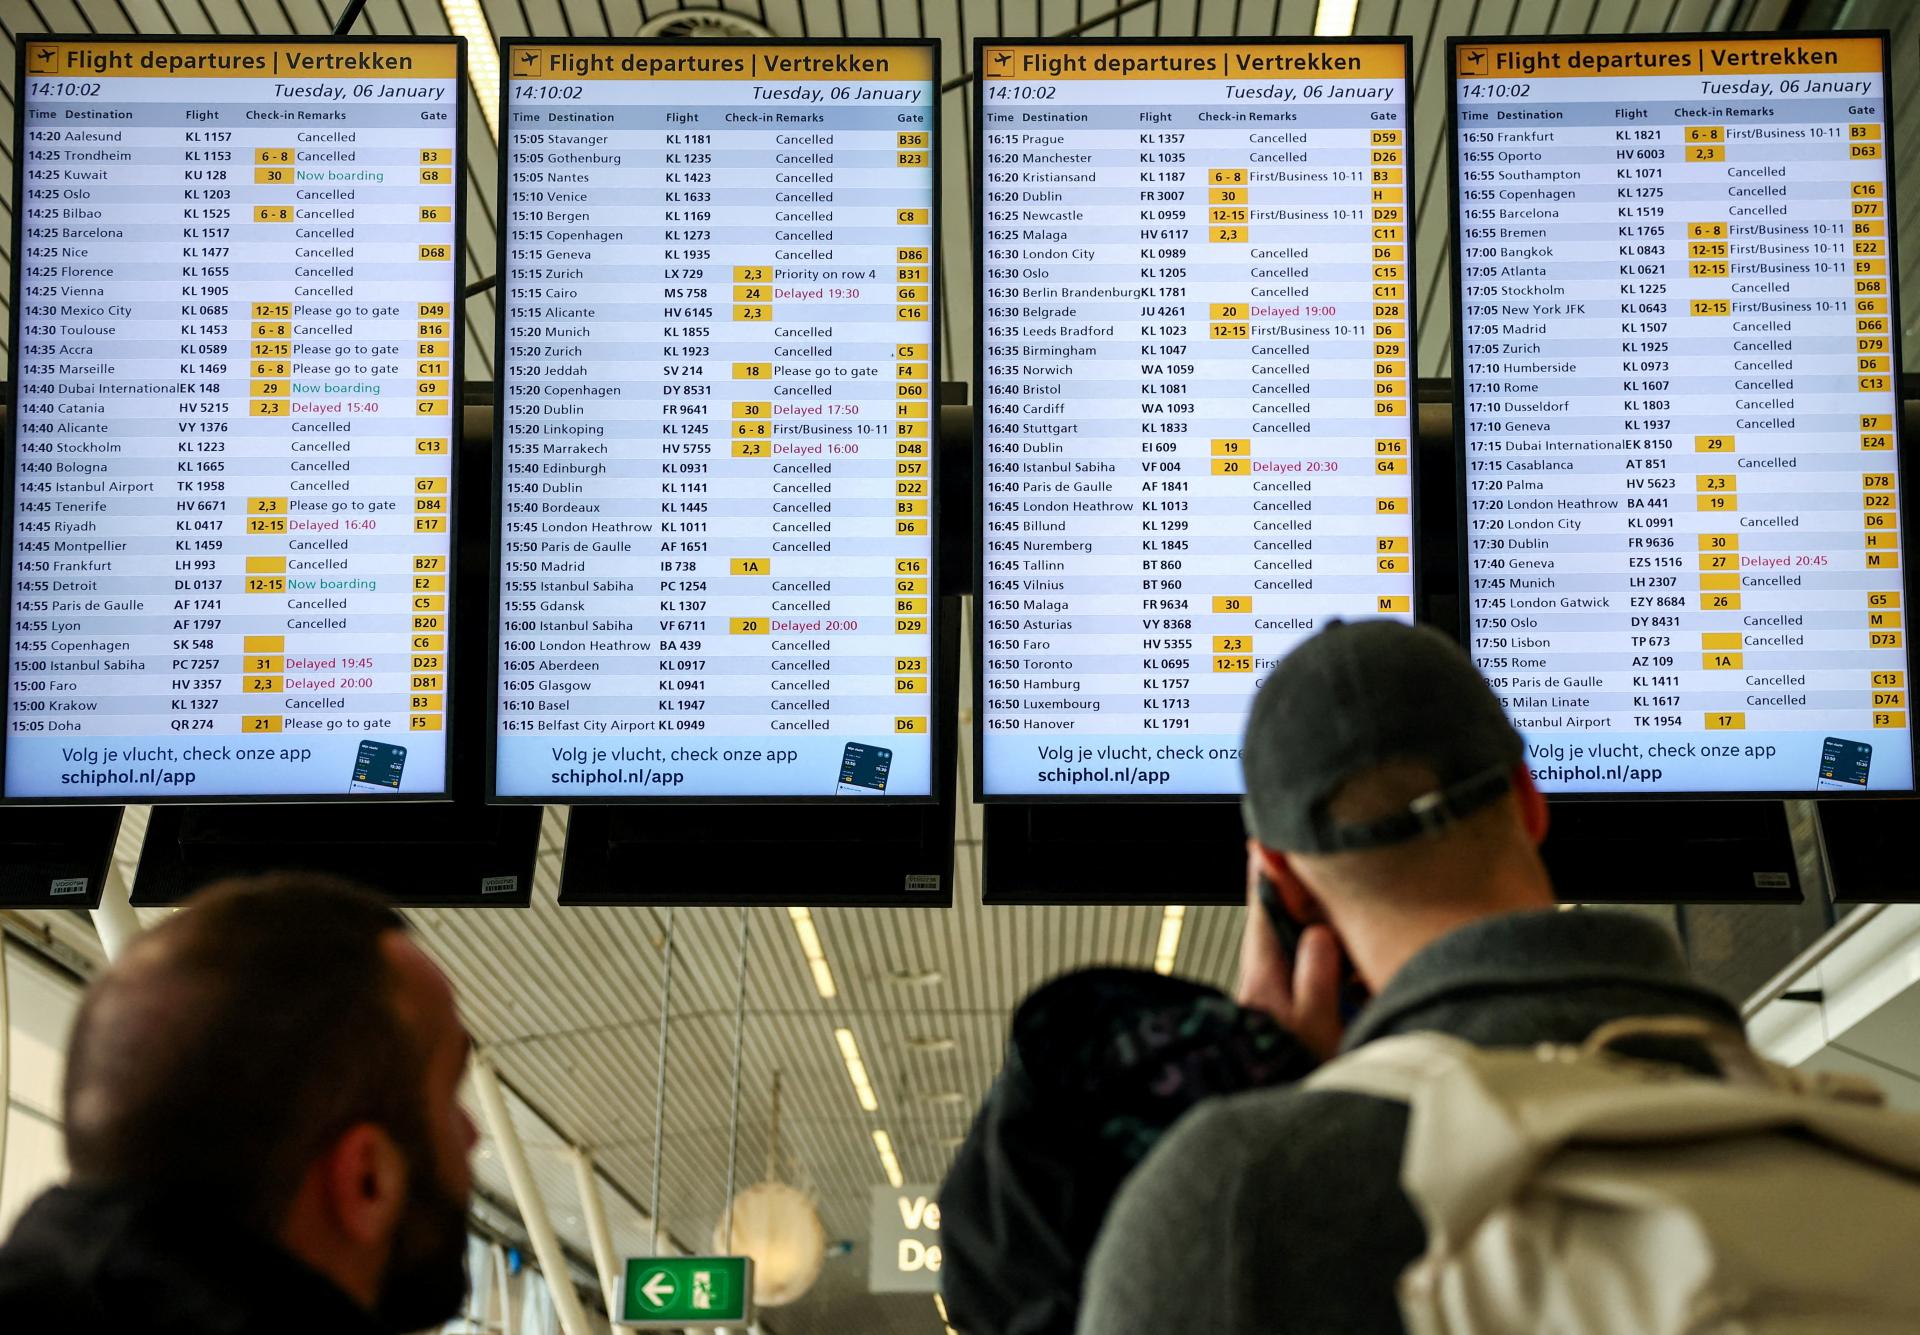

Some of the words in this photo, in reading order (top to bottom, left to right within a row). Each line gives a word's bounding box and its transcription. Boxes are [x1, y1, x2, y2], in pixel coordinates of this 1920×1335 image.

[67, 49, 133, 74] Flight
[140, 48, 266, 75] departures
[285, 51, 412, 70] Vertrekken
[550, 53, 615, 77] Flight
[621, 53, 745, 77] departures
[763, 53, 889, 72] Vertrekken
[1023, 53, 1087, 77] Flight
[1093, 53, 1217, 76] departures
[1235, 52, 1361, 71] Vertrekken
[1496, 50, 1561, 74] Flight
[1567, 50, 1692, 73] departures
[1710, 46, 1838, 67] Vertrekken
[29, 82, 101, 97] 14:10:02
[274, 83, 347, 101] Tuesday,
[353, 84, 374, 98] 06
[377, 84, 445, 101] January
[515, 85, 583, 100] 14:10:02
[752, 85, 824, 104] Tuesday,
[830, 86, 851, 100] 06
[854, 86, 922, 104] January
[988, 86, 1056, 100] 14:10:02
[1225, 84, 1297, 102] Tuesday,
[1303, 85, 1324, 99] 06
[1326, 84, 1394, 102] January
[1462, 83, 1531, 99] 14:10:02
[1701, 79, 1774, 97] Tuesday,
[1779, 79, 1800, 93] 06
[1803, 79, 1872, 96] January
[28, 108, 57, 119] Time
[65, 109, 133, 119] Destination
[185, 109, 220, 122] Flight
[245, 109, 295, 120] Check-in
[297, 110, 347, 120] Remarks
[420, 111, 448, 121] Gate
[1460, 110, 1489, 121] Time
[1497, 109, 1563, 120] Destination
[1615, 108, 1648, 121] Flight
[1674, 106, 1723, 118] Check-in
[1725, 106, 1775, 117] Remarks
[1848, 105, 1876, 115] Gate
[27, 169, 60, 180] 14:25
[64, 169, 108, 180] Kuwait
[184, 170, 203, 180] KU
[206, 170, 227, 180] 128
[267, 170, 282, 181] 30
[296, 170, 324, 181] Now
[327, 169, 385, 184] boarding
[422, 170, 439, 181] G8
[987, 210, 1019, 221] 16:25
[1022, 210, 1084, 221] Newcastle
[1140, 210, 1156, 220] KL
[1157, 210, 1186, 220] 0959
[1212, 210, 1245, 221] 12-15
[1250, 209, 1329, 220] First/Business
[1333, 209, 1363, 220] 10-11
[1374, 209, 1398, 220] D29
[511, 268, 543, 279] 15:15
[545, 268, 583, 279] Zurich
[664, 269, 680, 279] LX
[682, 268, 704, 279] 729
[744, 269, 762, 281] 2,3
[775, 268, 819, 282] Priority
[822, 271, 838, 280] on
[841, 271, 866, 280] row
[868, 269, 876, 280] 4
[899, 269, 920, 280] B31
[1466, 305, 1498, 316] 17:05
[1502, 305, 1530, 315] New
[1532, 303, 1562, 315] York
[1565, 304, 1586, 314] JFK
[1621, 303, 1637, 314] KL
[1638, 303, 1667, 314] 0643
[1694, 302, 1727, 313] 12-15
[1732, 301, 1812, 313] First/Business
[1815, 301, 1847, 312] 10-11
[1857, 300, 1875, 311] G6
[988, 423, 1020, 434] 16:40
[1022, 423, 1078, 436] Stuttgart
[1142, 423, 1158, 433] KL
[1160, 422, 1188, 433] 1833
[1252, 421, 1311, 433] Cancelled
[506, 522, 538, 533] 15:45
[541, 521, 588, 533] London
[591, 521, 653, 533] Heathrow
[661, 522, 677, 533] KL
[679, 522, 707, 532] 1011
[772, 521, 831, 532] Cancelled
[898, 522, 915, 532] D6
[1473, 558, 1505, 569] 17:40
[1508, 558, 1555, 569] Geneva
[1629, 557, 1652, 568] EZS
[1654, 556, 1683, 567] 1516
[1712, 556, 1727, 568] 27
[1741, 555, 1791, 569] Delayed
[1795, 555, 1828, 566] 20:45
[1868, 555, 1880, 566] M
[13, 660, 47, 672] 15:00
[50, 659, 100, 671] Istanbul
[103, 659, 145, 671] Sabiha
[172, 659, 189, 670] PC
[190, 659, 220, 670] 7257
[256, 659, 270, 670] 31
[286, 657, 336, 672] Delayed
[341, 657, 373, 669] 19:45
[413, 657, 438, 668] D23
[987, 699, 1020, 710] 16:50
[1023, 698, 1100, 712] Luxembourg
[1143, 698, 1160, 709] KL
[1162, 698, 1190, 709] 1713
[502, 720, 534, 731] 16:15
[538, 719, 580, 731] Belfast
[583, 719, 607, 734] City
[610, 719, 656, 733] Airport
[658, 720, 675, 731] KL
[676, 720, 705, 730] 0949
[770, 719, 830, 730] Cancelled
[897, 719, 914, 730] D6
[62, 746, 98, 765] Volg
[102, 750, 118, 765] je
[122, 746, 178, 763] vlucht,
[182, 745, 231, 761] check
[235, 749, 276, 760] onze
[279, 748, 312, 763] app
[551, 746, 588, 765] Volg
[591, 750, 607, 765] je
[611, 746, 666, 764] vlucht,
[670, 746, 719, 762] check
[723, 750, 762, 761] onze
[766, 750, 798, 764] app
[1037, 745, 1073, 764] Volg
[1077, 749, 1093, 763] je
[1096, 745, 1152, 762] vlucht,
[1156, 744, 1204, 760] check
[1528, 743, 1565, 762] Volg
[1568, 747, 1584, 761] je
[1587, 743, 1643, 760] vlucht,
[1647, 742, 1697, 758] check
[1700, 745, 1740, 757] onze
[1744, 745, 1776, 760] app
[61, 768, 196, 787] schiphol.nl/app
[551, 768, 684, 787] schiphol.nl/app
[1038, 767, 1170, 785] schiphol.nl/app
[1529, 764, 1663, 783] schiphol.nl/app
